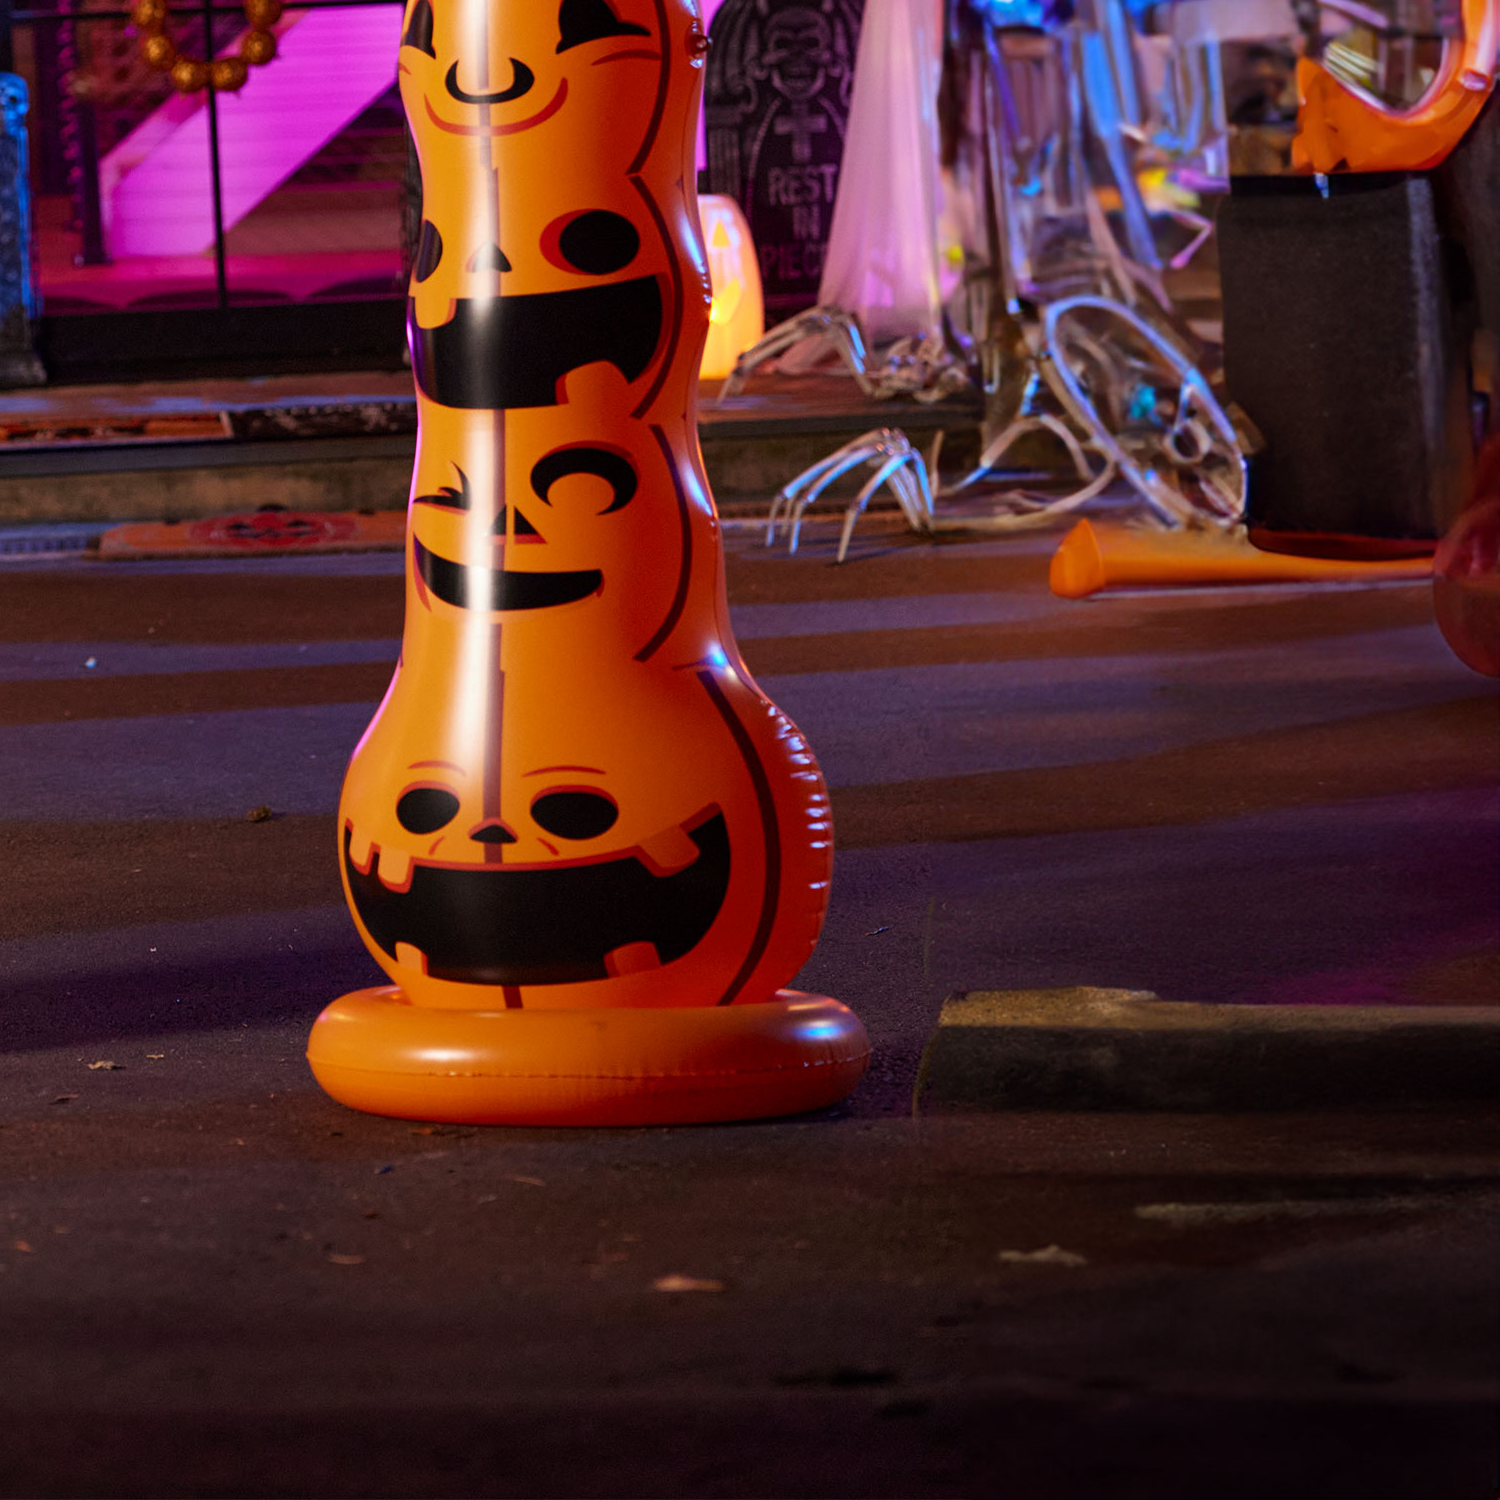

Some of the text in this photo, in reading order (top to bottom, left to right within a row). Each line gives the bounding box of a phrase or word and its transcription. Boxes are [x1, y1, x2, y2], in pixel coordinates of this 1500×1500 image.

[767, 163, 838, 205] REST
[792, 203, 820, 240] IN
[760, 242, 825, 280] PIEC
